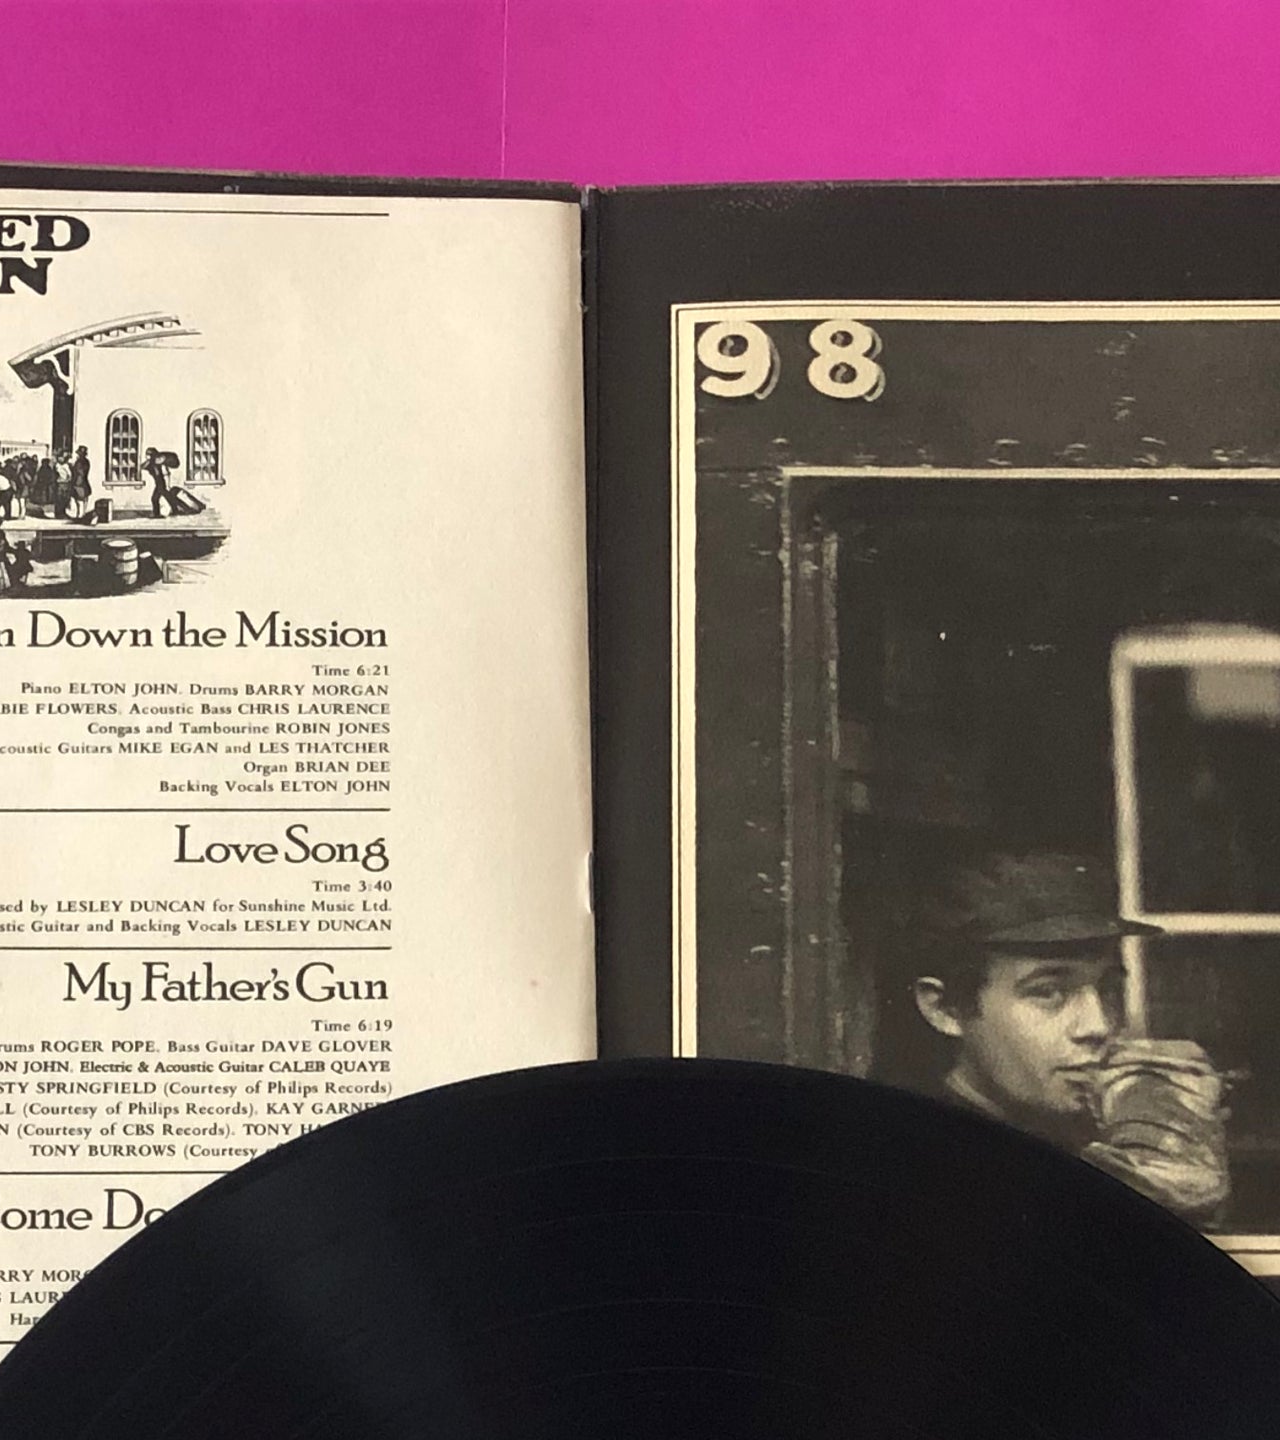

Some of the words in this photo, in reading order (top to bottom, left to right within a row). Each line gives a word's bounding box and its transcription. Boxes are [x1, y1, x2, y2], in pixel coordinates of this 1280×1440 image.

[26, 609, 154, 649] Down
[161, 610, 228, 649] the
[234, 610, 389, 648] Mission
[311, 664, 351, 677] Time
[356, 663, 389, 677] 6:21
[86, 721, 141, 739] Congas
[145, 720, 173, 735] and
[178, 720, 270, 735] Tambourine
[275, 722, 331, 735] ROBIN
[335, 721, 391, 738] JONES
[173, 823, 280, 865] Love
[283, 823, 390, 873] Song
[30, 899, 49, 917] by
[56, 900, 124, 913] LESLEY
[130, 899, 206, 913] DUNCAN
[212, 898, 235, 913] for
[238, 898, 306, 913] Sunshine
[311, 899, 355, 913] Music
[361, 898, 392, 912] Ltd.
[62, 961, 132, 1011] My
[140, 960, 290, 1003] Father's
[295, 961, 389, 1003] Gun
[310, 1019, 352, 1033] Time
[357, 1018, 393, 1032] 6:19
